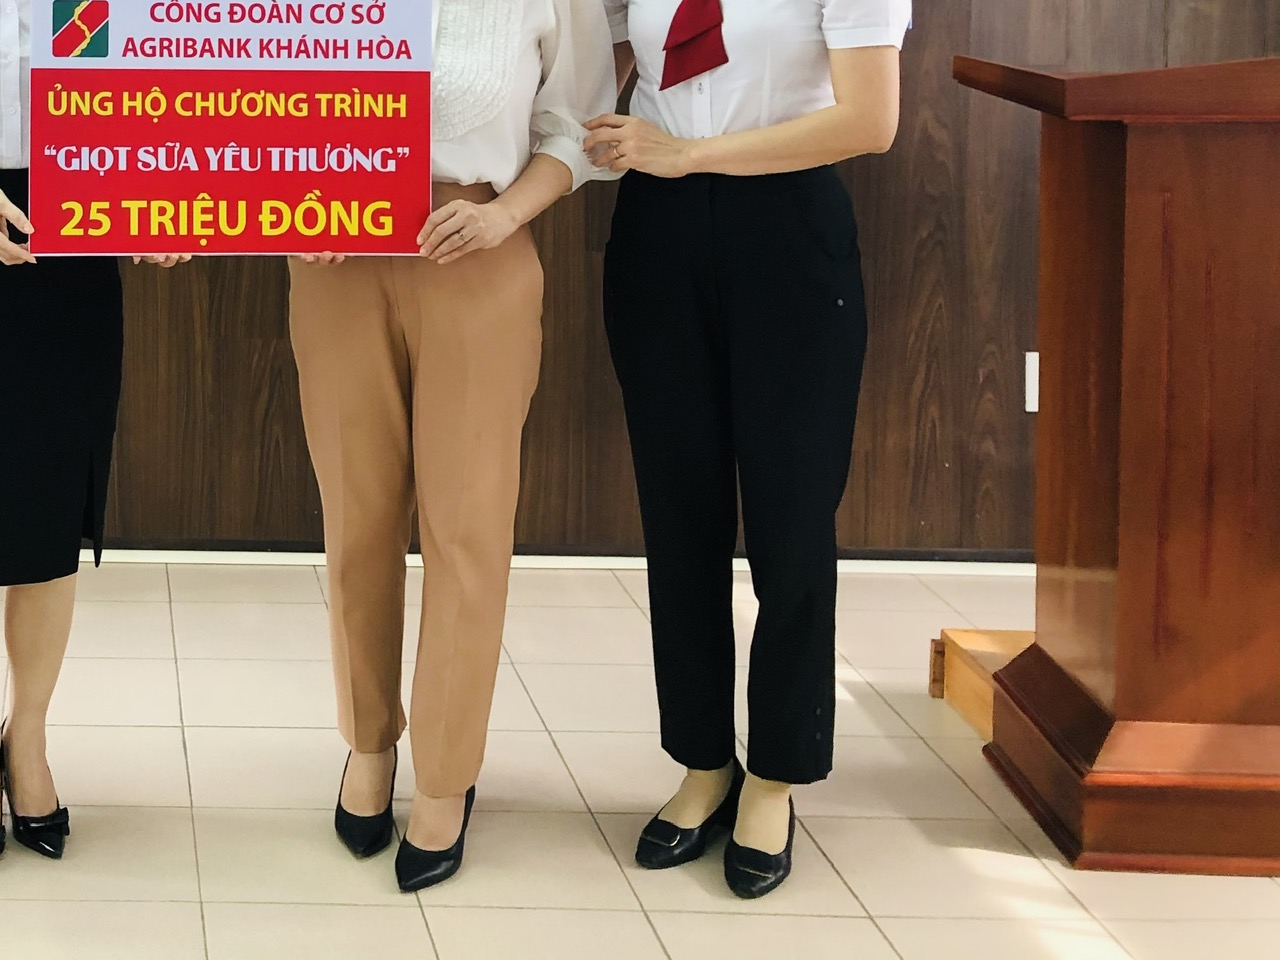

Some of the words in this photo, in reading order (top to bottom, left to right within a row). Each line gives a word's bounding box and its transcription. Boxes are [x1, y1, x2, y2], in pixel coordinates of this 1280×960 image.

[228, 0, 302, 25] ĐOÀN
[309, 2, 346, 25] CƠ
[351, 0, 387, 26] SỞ
[122, 37, 252, 59] AGRIBANK
[259, 32, 350, 60] KHÁNH
[356, 33, 413, 61] HÒA
[47, 83, 114, 117] ỦNG
[123, 86, 168, 124] HỘ
[175, 88, 309, 118] CHƯƠNG
[315, 87, 408, 119] TRÌNH
[44, 144, 132, 177] “GIỌT
[137, 142, 199, 172] SỮA
[204, 142, 263, 173] YÊU
[268, 143, 410, 173] THƯƠNG”
[60, 201, 111, 237] 25
[121, 192, 247, 246] TRIỆU
[258, 189, 394, 237] ĐỒNG
